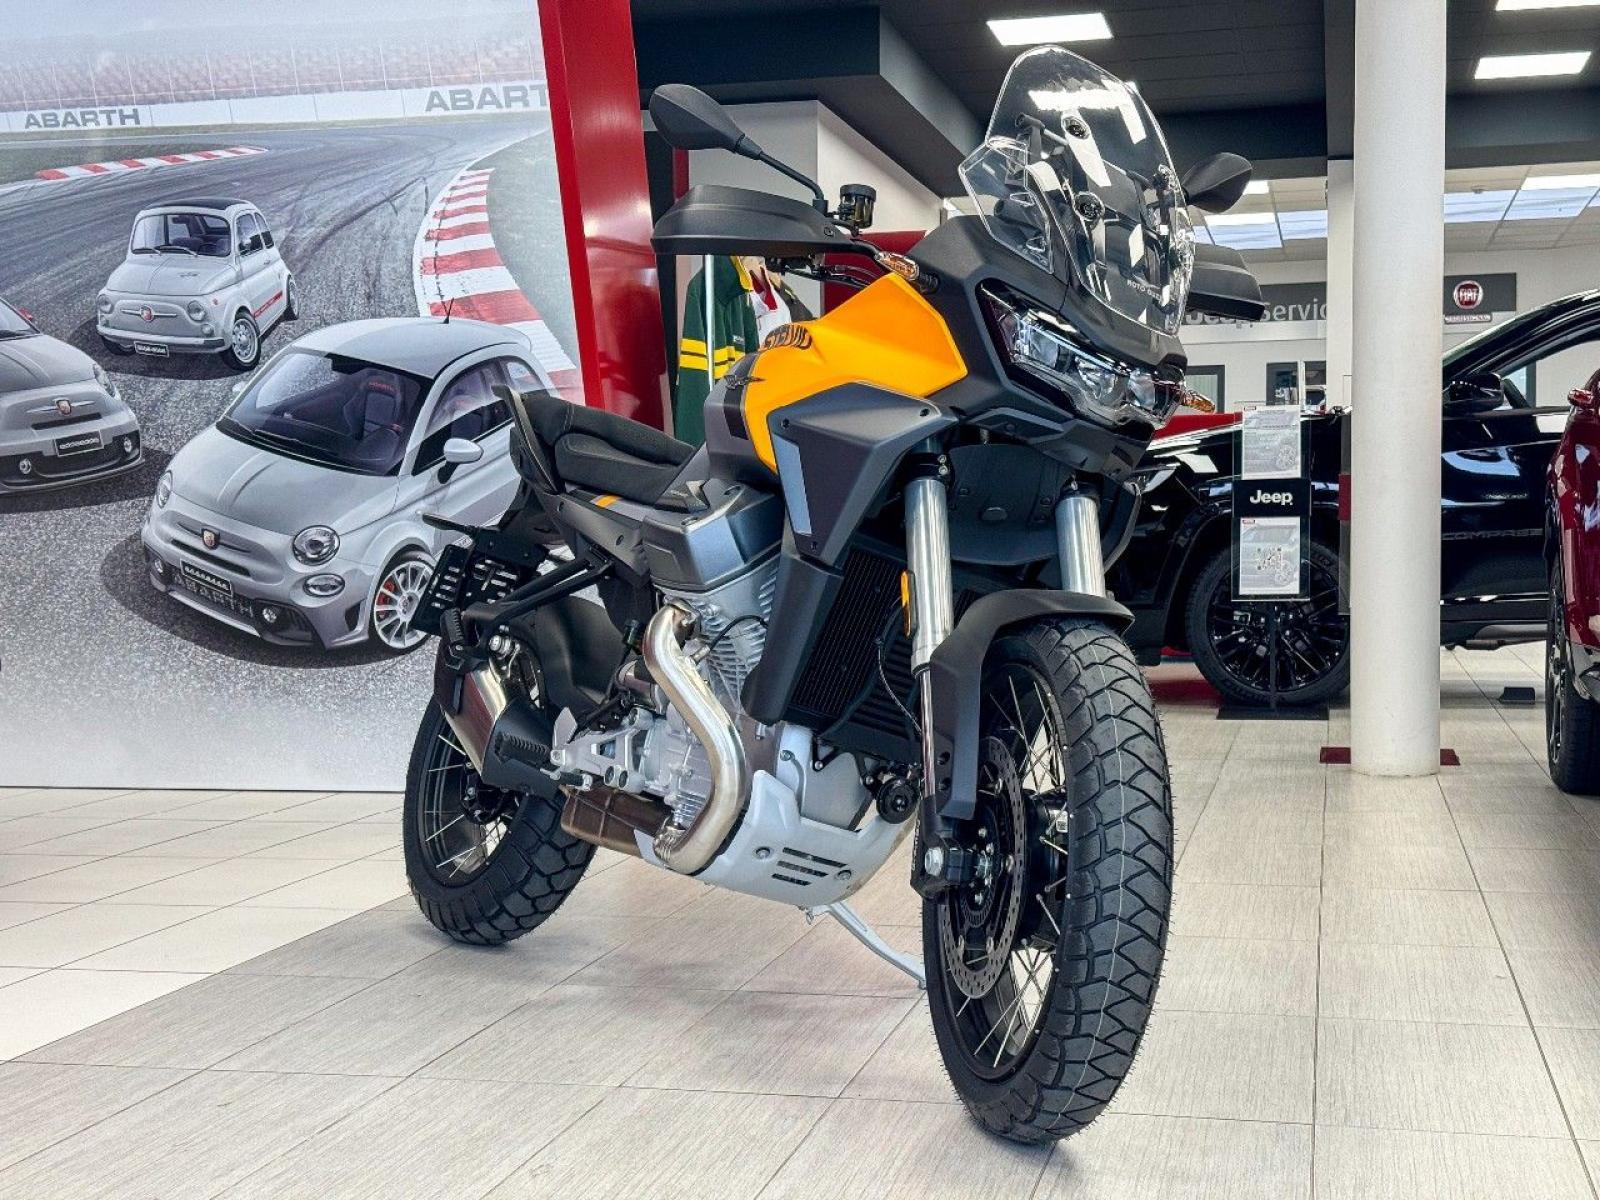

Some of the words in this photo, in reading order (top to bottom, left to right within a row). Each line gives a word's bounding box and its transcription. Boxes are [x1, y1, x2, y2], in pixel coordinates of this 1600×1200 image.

[25, 108, 140, 129] ABARTH
[1459, 288, 1480, 302] FIAT
[1249, 489, 1294, 506] Jeep
